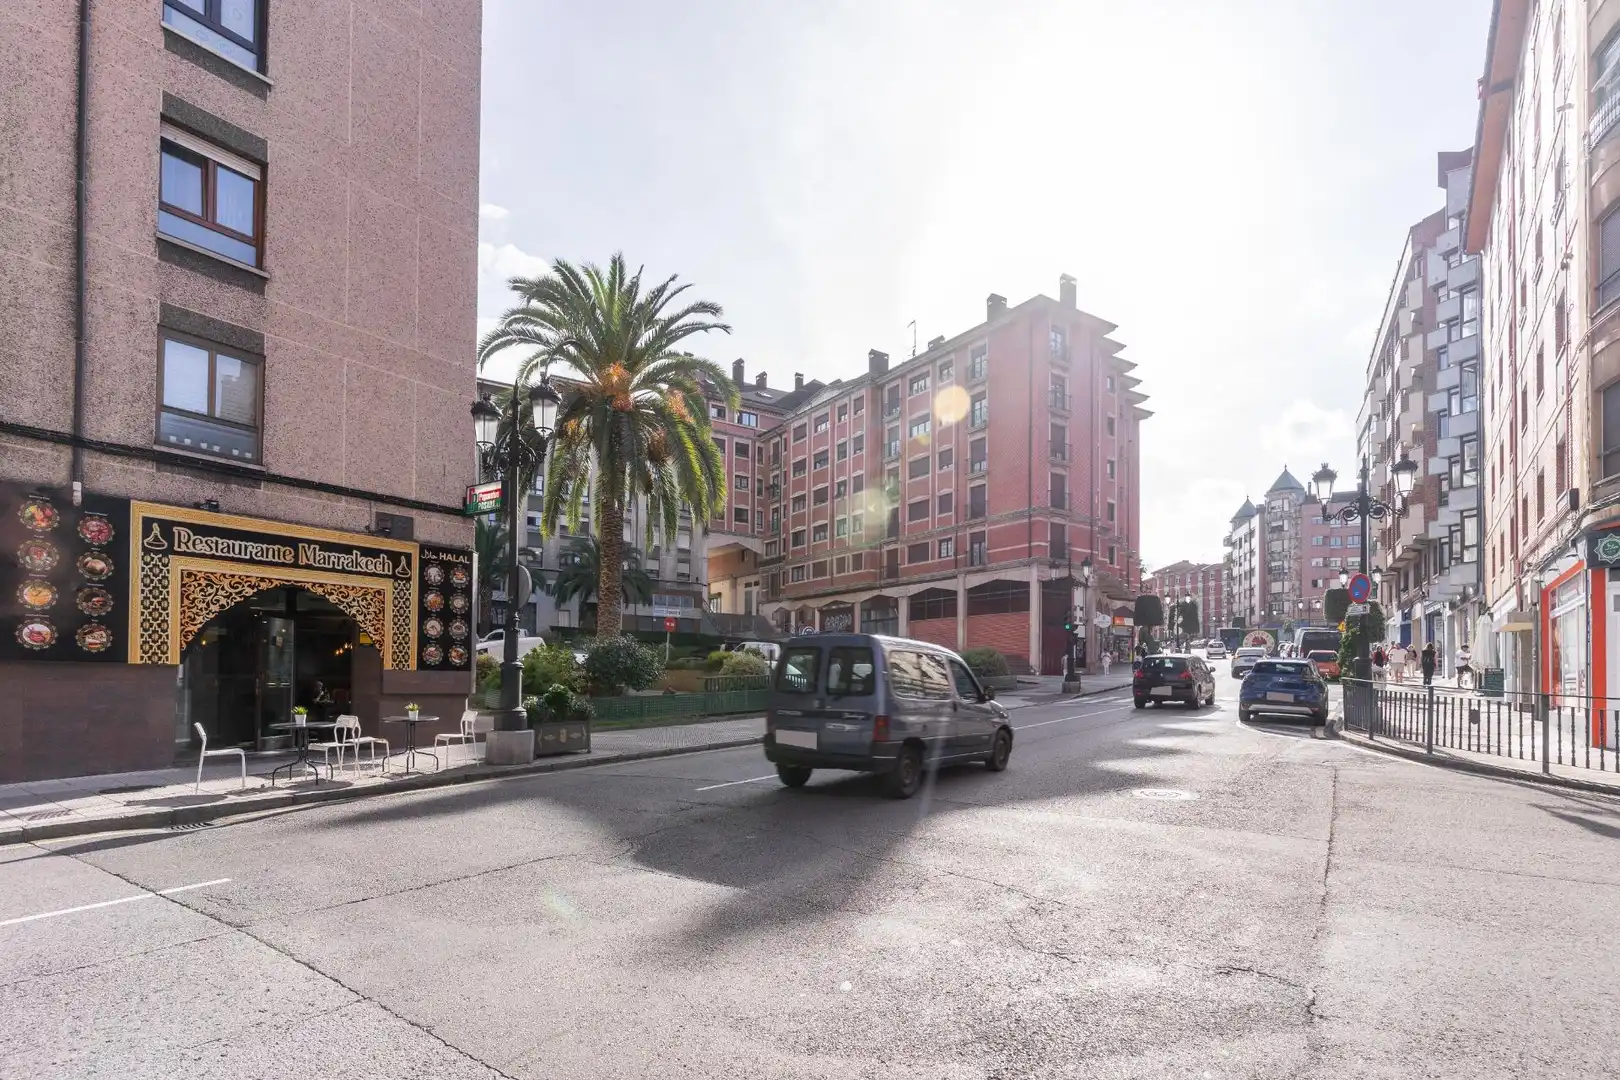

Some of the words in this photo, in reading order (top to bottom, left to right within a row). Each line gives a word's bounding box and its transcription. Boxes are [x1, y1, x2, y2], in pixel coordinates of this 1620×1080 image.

[173, 527, 294, 564] Restaurante
[299, 543, 392, 575] Marrakech
[439, 552, 470, 564] HALAL
